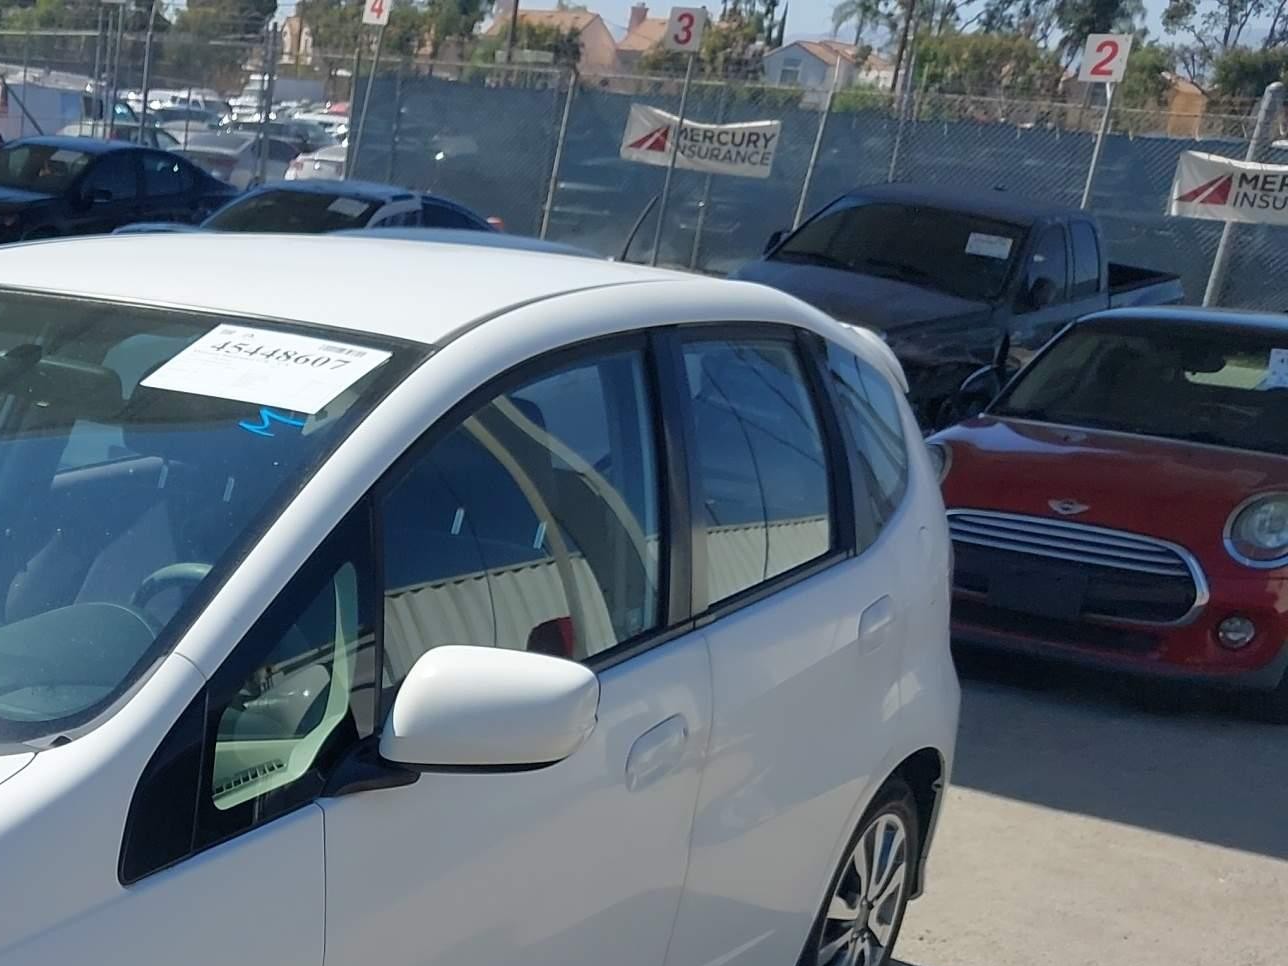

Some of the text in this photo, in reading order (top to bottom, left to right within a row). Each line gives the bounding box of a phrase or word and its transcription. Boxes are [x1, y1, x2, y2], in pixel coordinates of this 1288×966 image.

[370, 0, 384, 19] 4
[673, 12, 695, 46] 3
[1089, 39, 1120, 76] 2
[673, 127, 776, 150] MERCURY
[210, 340, 352, 371] 45448607
